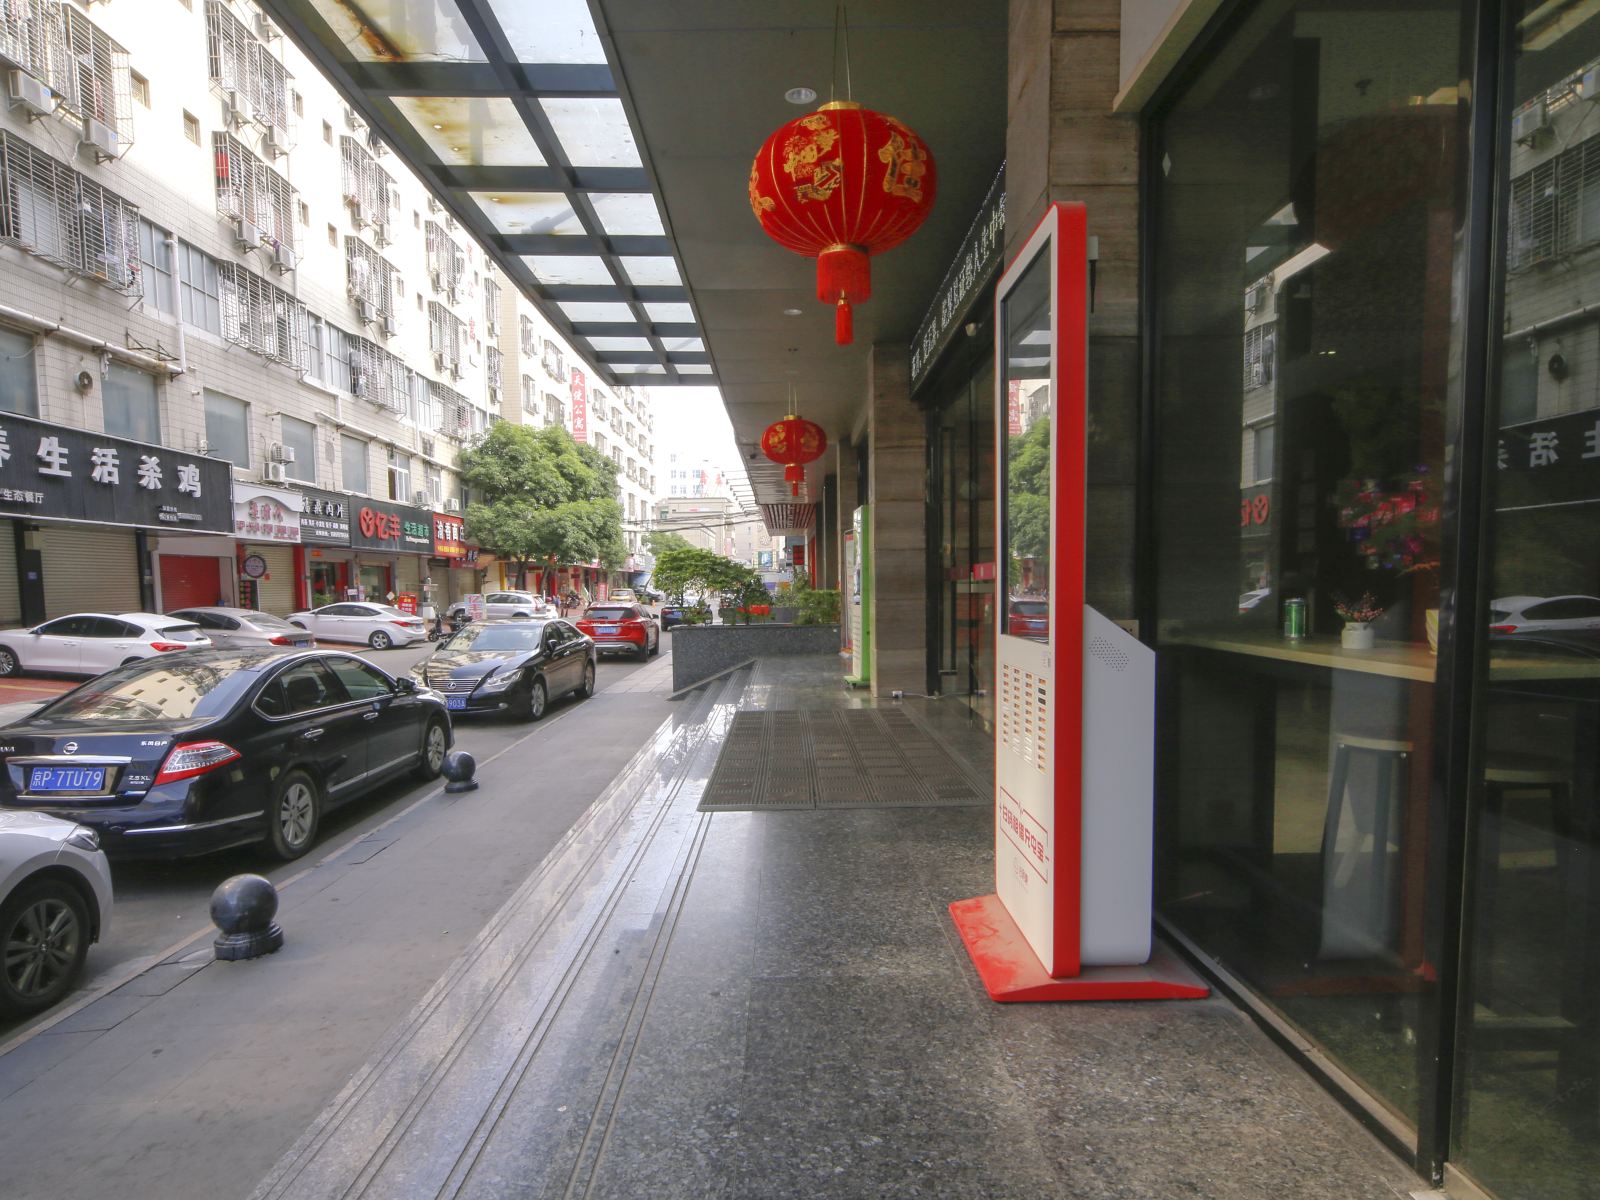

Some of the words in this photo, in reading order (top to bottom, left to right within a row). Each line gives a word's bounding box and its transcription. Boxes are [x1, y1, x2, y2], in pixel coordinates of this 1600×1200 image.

[573, 374, 585, 430] 天使公寓
[0, 488, 45, 504] 生态餐厅
[403, 520, 430, 538] 生活超市
